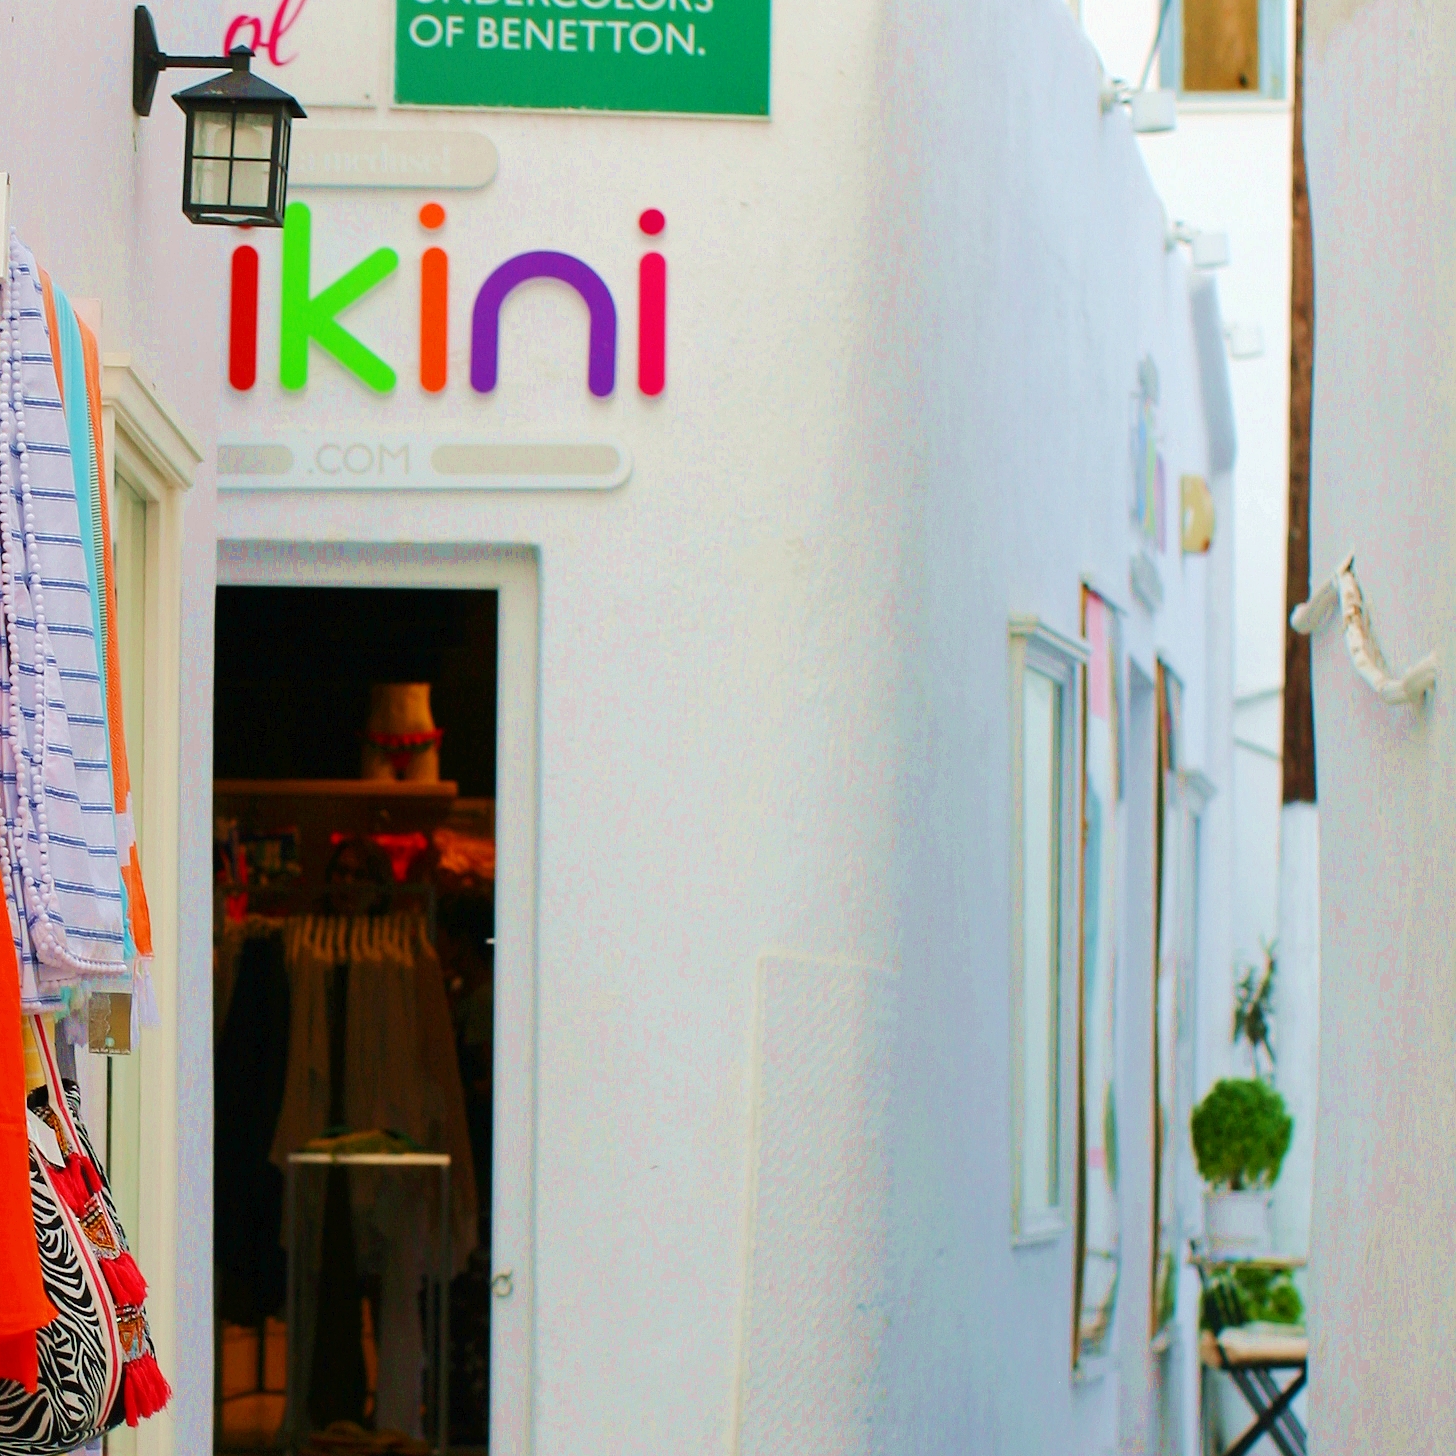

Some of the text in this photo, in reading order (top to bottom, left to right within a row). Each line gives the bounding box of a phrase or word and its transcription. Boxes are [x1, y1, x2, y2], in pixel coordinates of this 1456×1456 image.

[408, 13, 707, 56] OF BENETTON.
[306, 442, 410, 475] .COM
